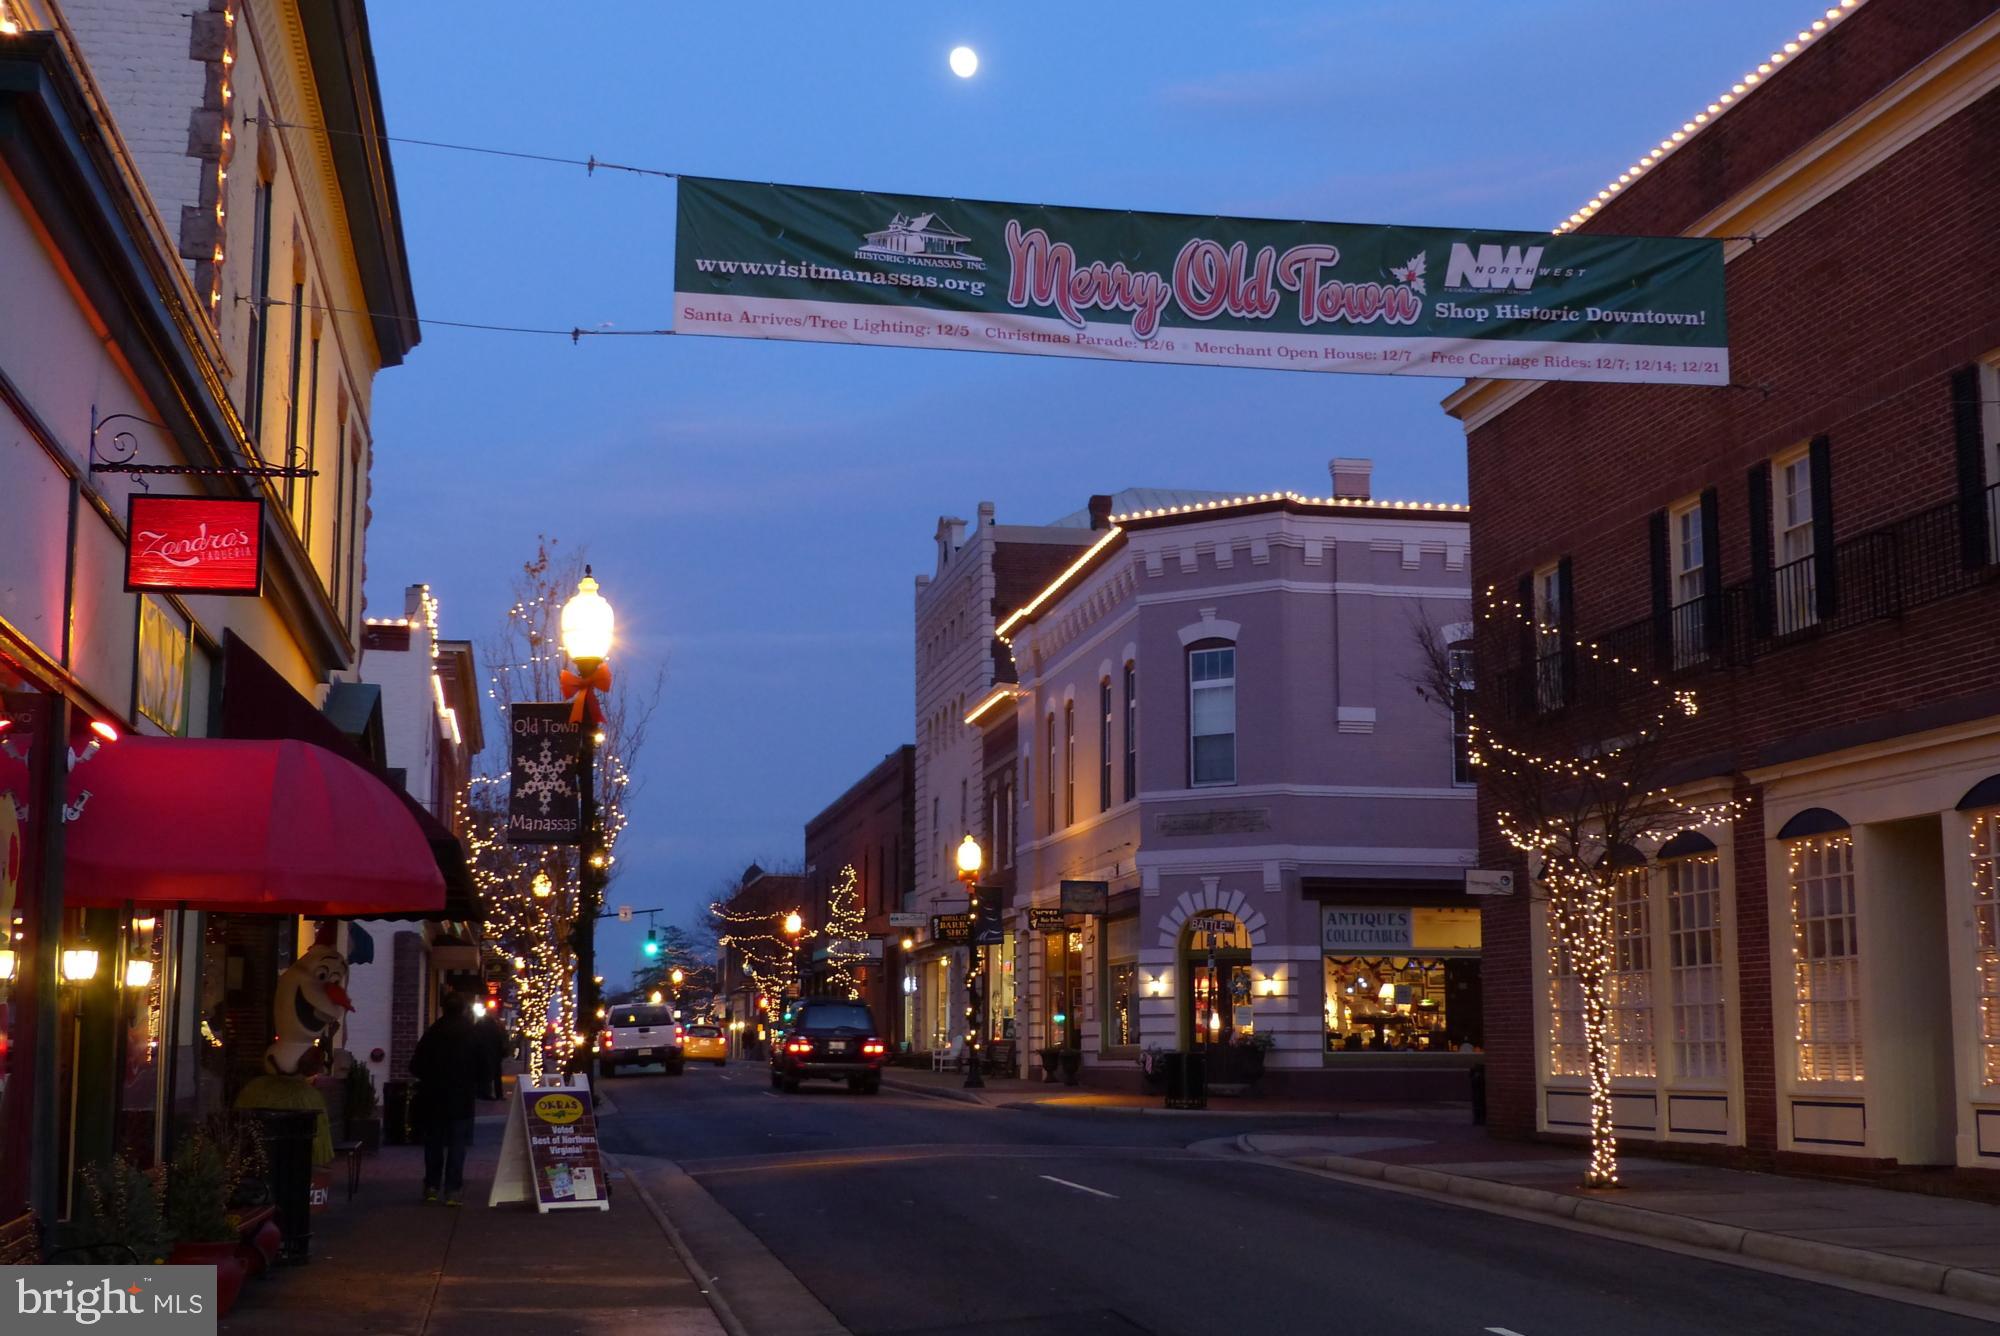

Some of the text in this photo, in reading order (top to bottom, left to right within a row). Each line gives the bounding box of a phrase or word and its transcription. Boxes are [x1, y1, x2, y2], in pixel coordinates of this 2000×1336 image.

[853, 250, 905, 265] HISTORIC
[906, 257, 964, 269] MANASSAS
[695, 258, 987, 296] www.visitmanassas.org
[1005, 219, 1422, 341] Merry Old Town
[1474, 265, 1587, 277] NORTHWEST
[1435, 302, 1706, 325] Shop Historic Downtown!
[683, 306, 1719, 373] Santa Arrives/Tree Lighting: 12/5 Christmas Parade: 12/6 Merchant Open House: 12/7 Free Carriage Rides: 12/7; 12/14; 12/21
[138, 522, 249, 567] Zandra's
[514, 716, 579, 736] Old Town
[509, 813, 578, 832] Manassas
[1191, 919, 1226, 932] BATTLE
[1327, 912, 1407, 928] ANTIQUES
[1326, 928, 1409, 943] COLLECTABLES
[551, 1125, 574, 1134] Voted
[531, 1135, 595, 1145] Best of Northern
[549, 1146, 583, 1155] Virginia!
